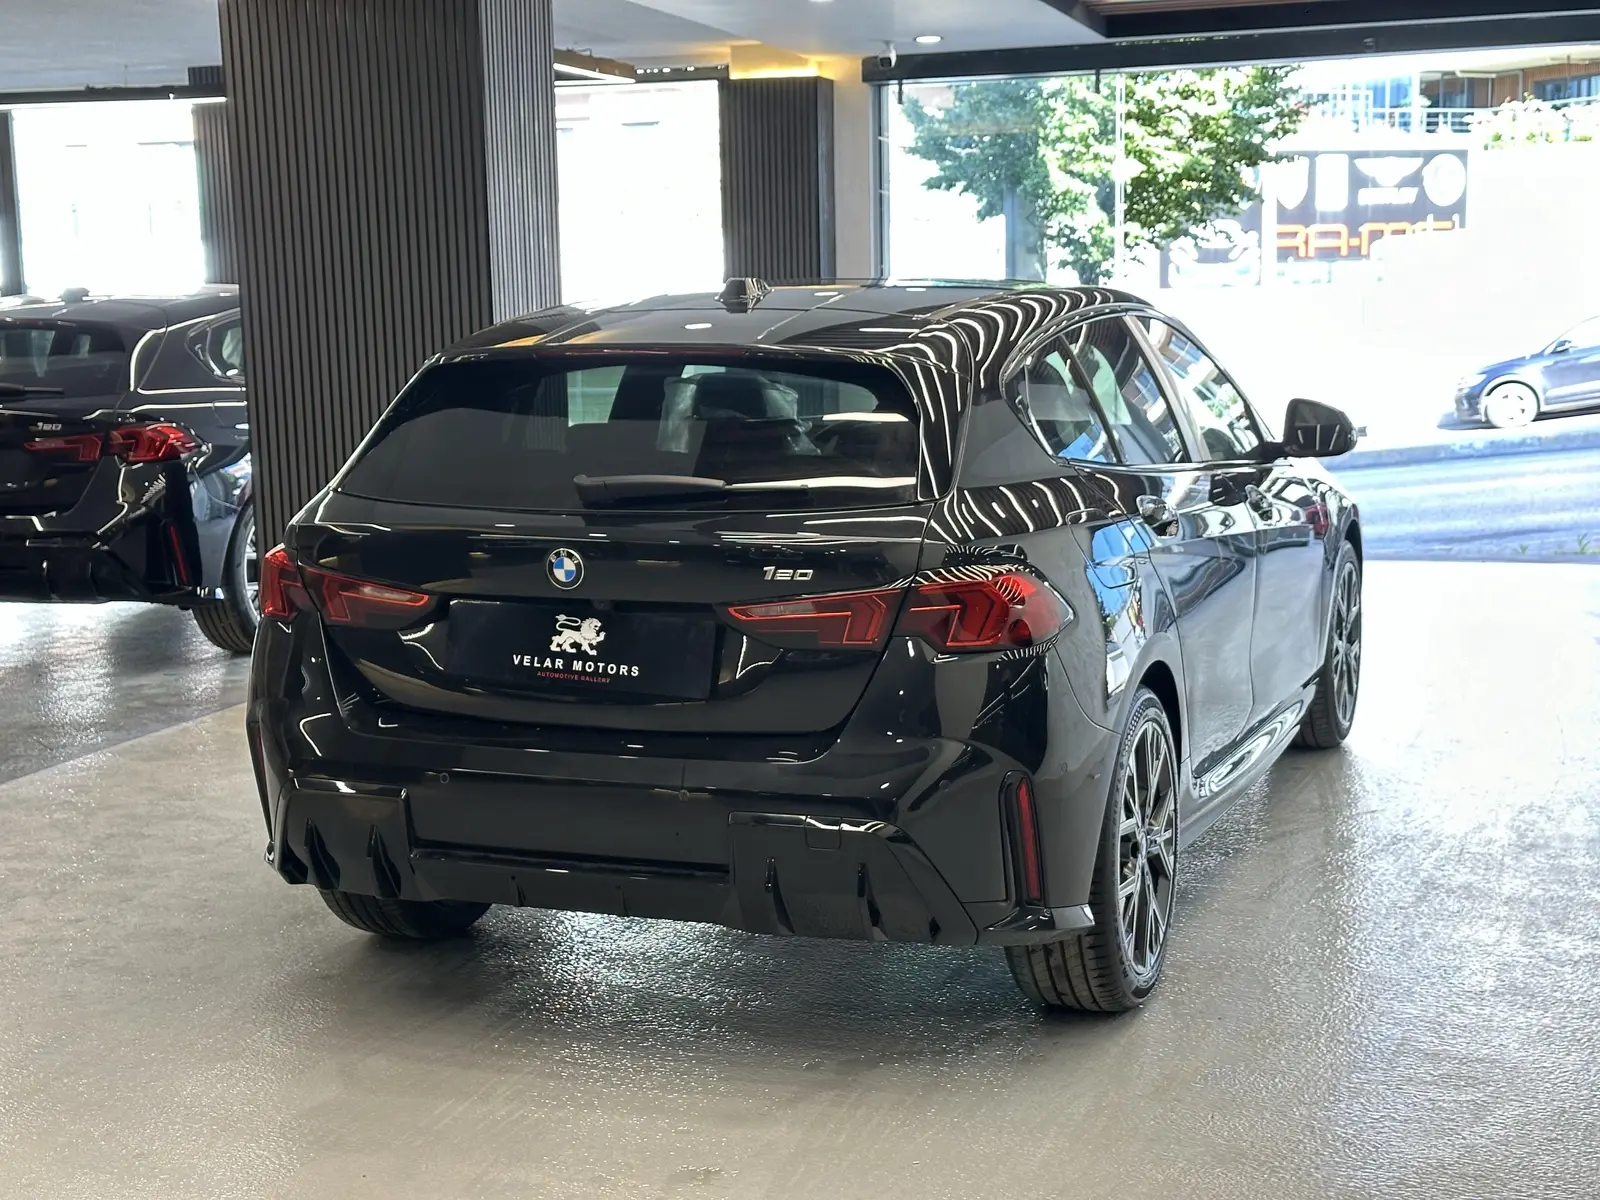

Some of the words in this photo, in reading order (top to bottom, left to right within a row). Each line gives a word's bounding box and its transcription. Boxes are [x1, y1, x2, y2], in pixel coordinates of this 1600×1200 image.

[762, 565, 814, 581] 120
[512, 654, 564, 670] VELAR
[572, 660, 640, 677] MOTORS
[536, 671, 579, 681] AUTOMOTIVE
[580, 674, 611, 684] GALLERY
